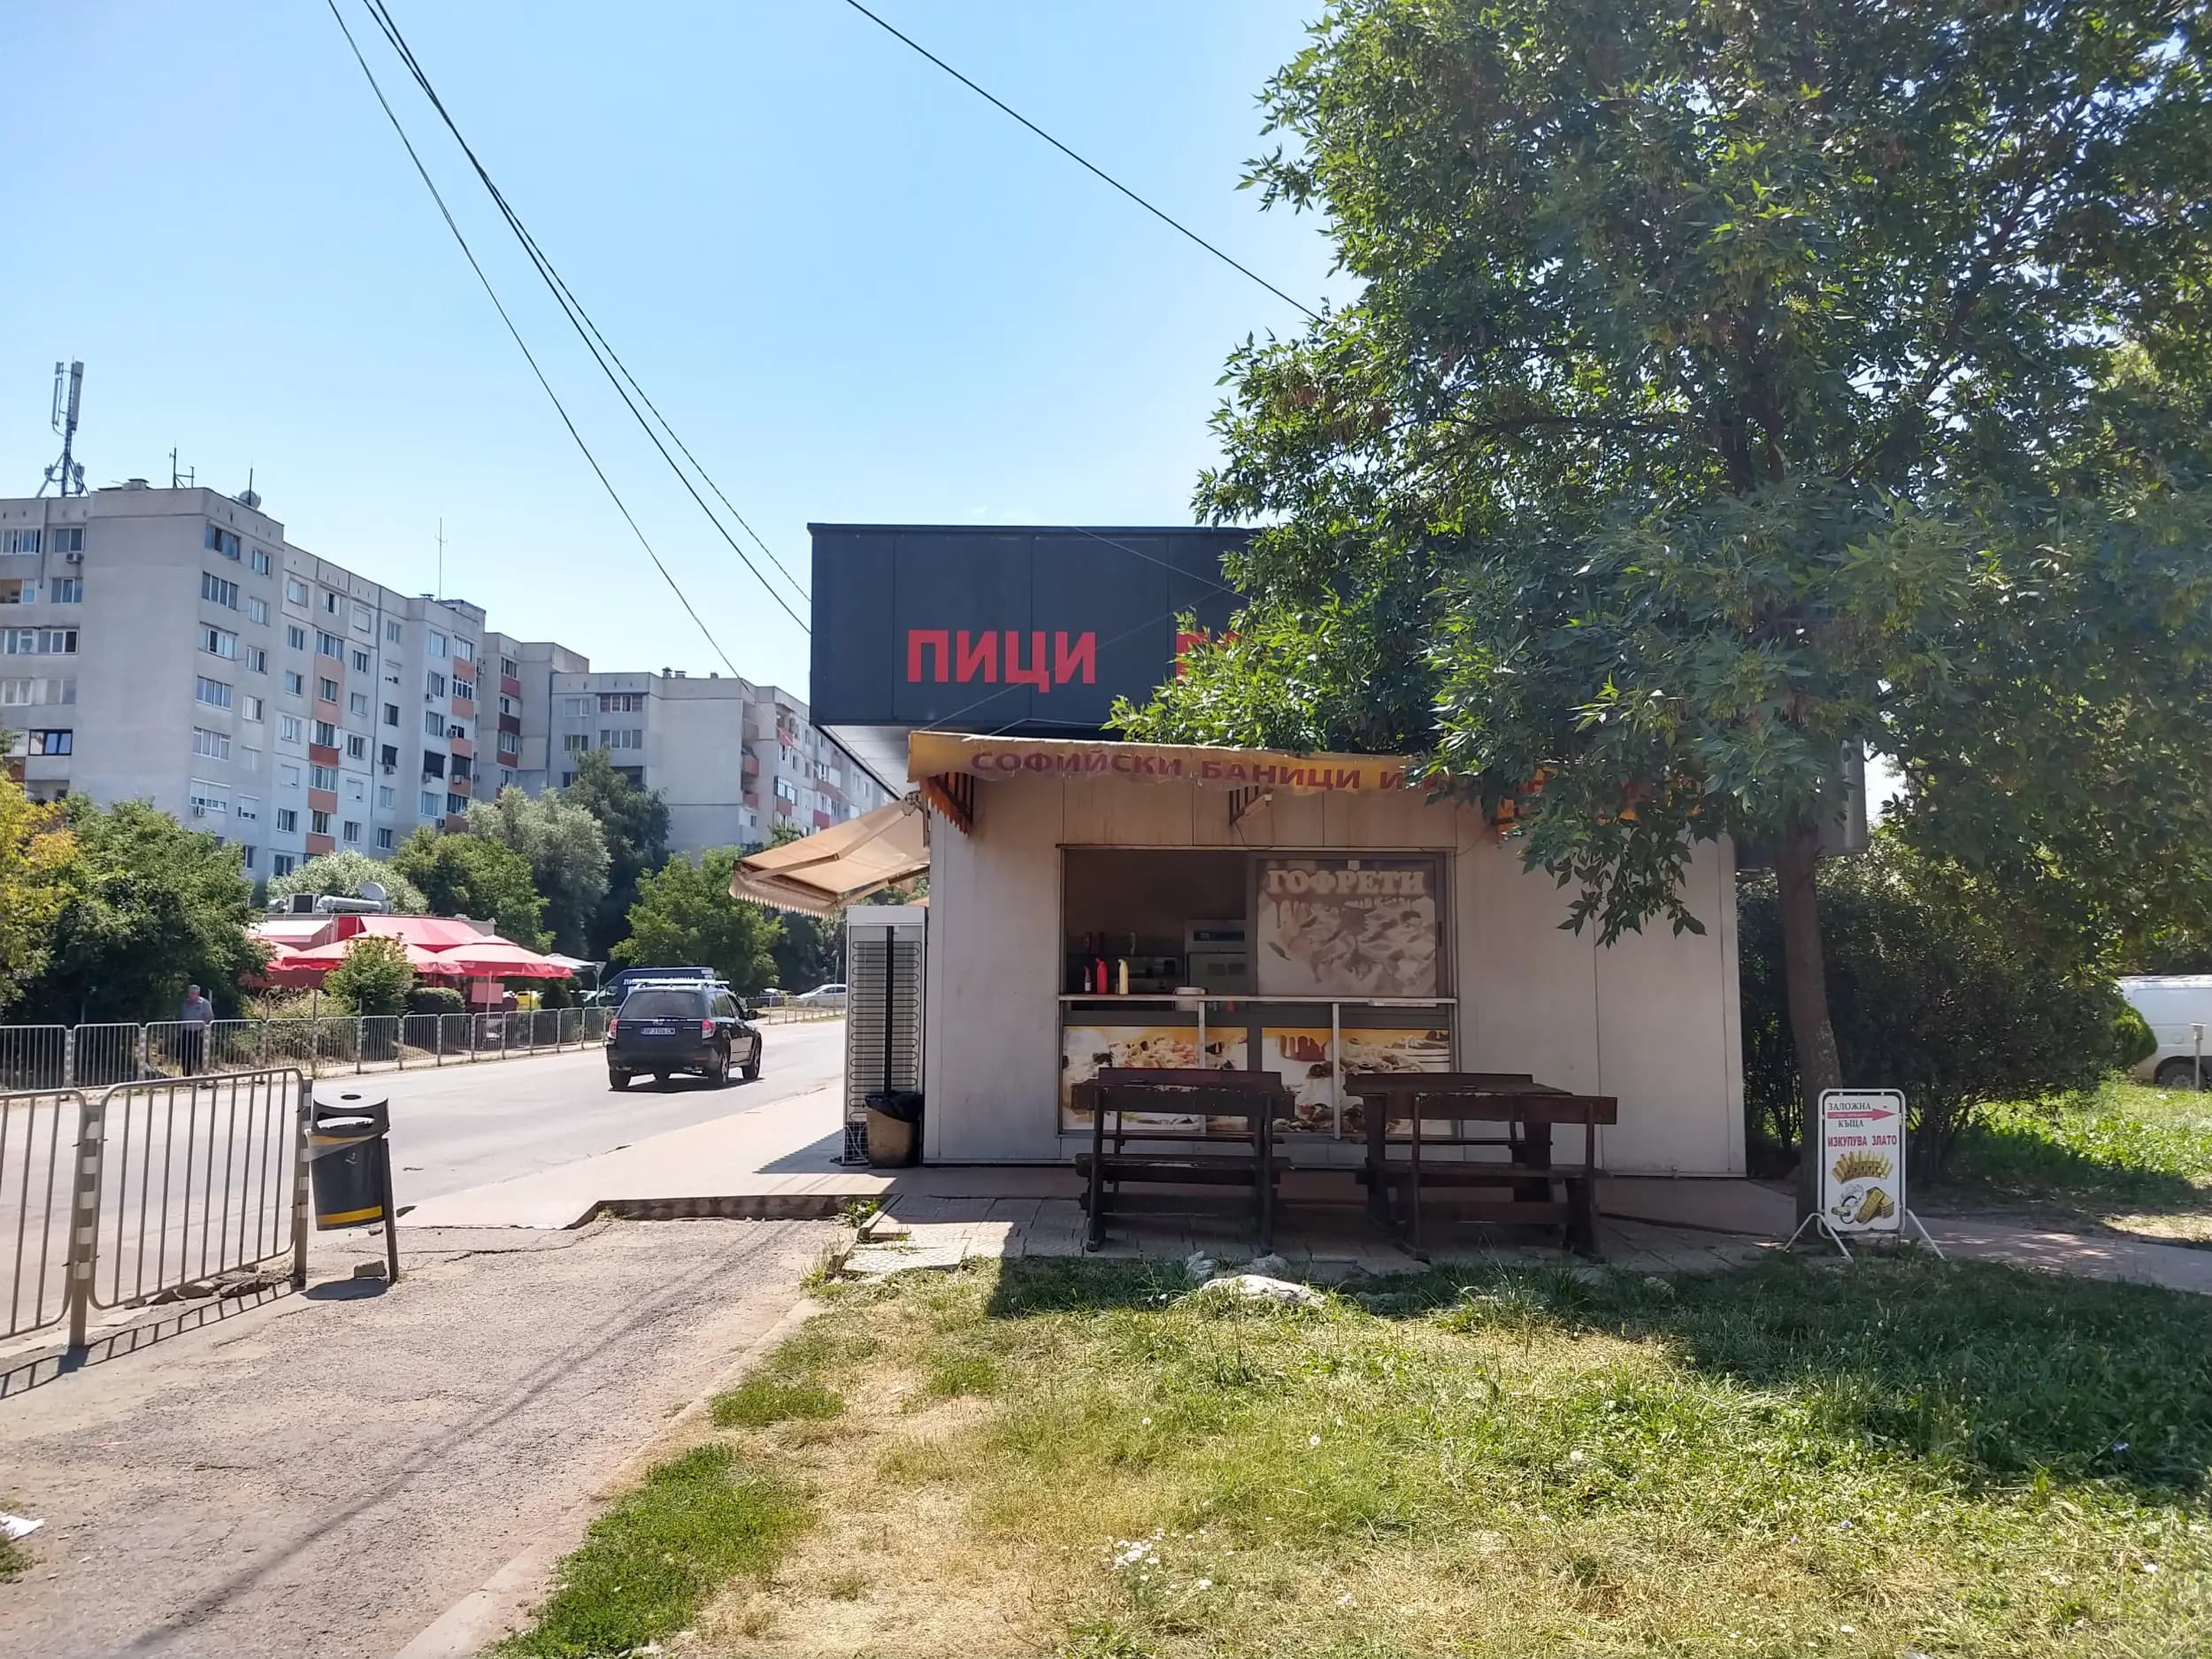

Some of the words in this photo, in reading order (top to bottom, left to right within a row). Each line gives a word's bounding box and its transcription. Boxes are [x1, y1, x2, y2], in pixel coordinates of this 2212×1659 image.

[907, 629, 1096, 693] ПИЦИ
[971, 749, 1182, 778] СОФИЙСКИ
[1201, 760, 1361, 790] БАНИЦИ
[1265, 869, 1425, 896] ГОФРЕТИ
[1827, 1102, 1871, 1111] ЗАЛОЖНА
[1838, 1119, 1864, 1129] КЪЩА
[1827, 1135, 1868, 1148] ИЗКУПУВА
[1871, 1134, 1897, 1146] ЗЛАТО
